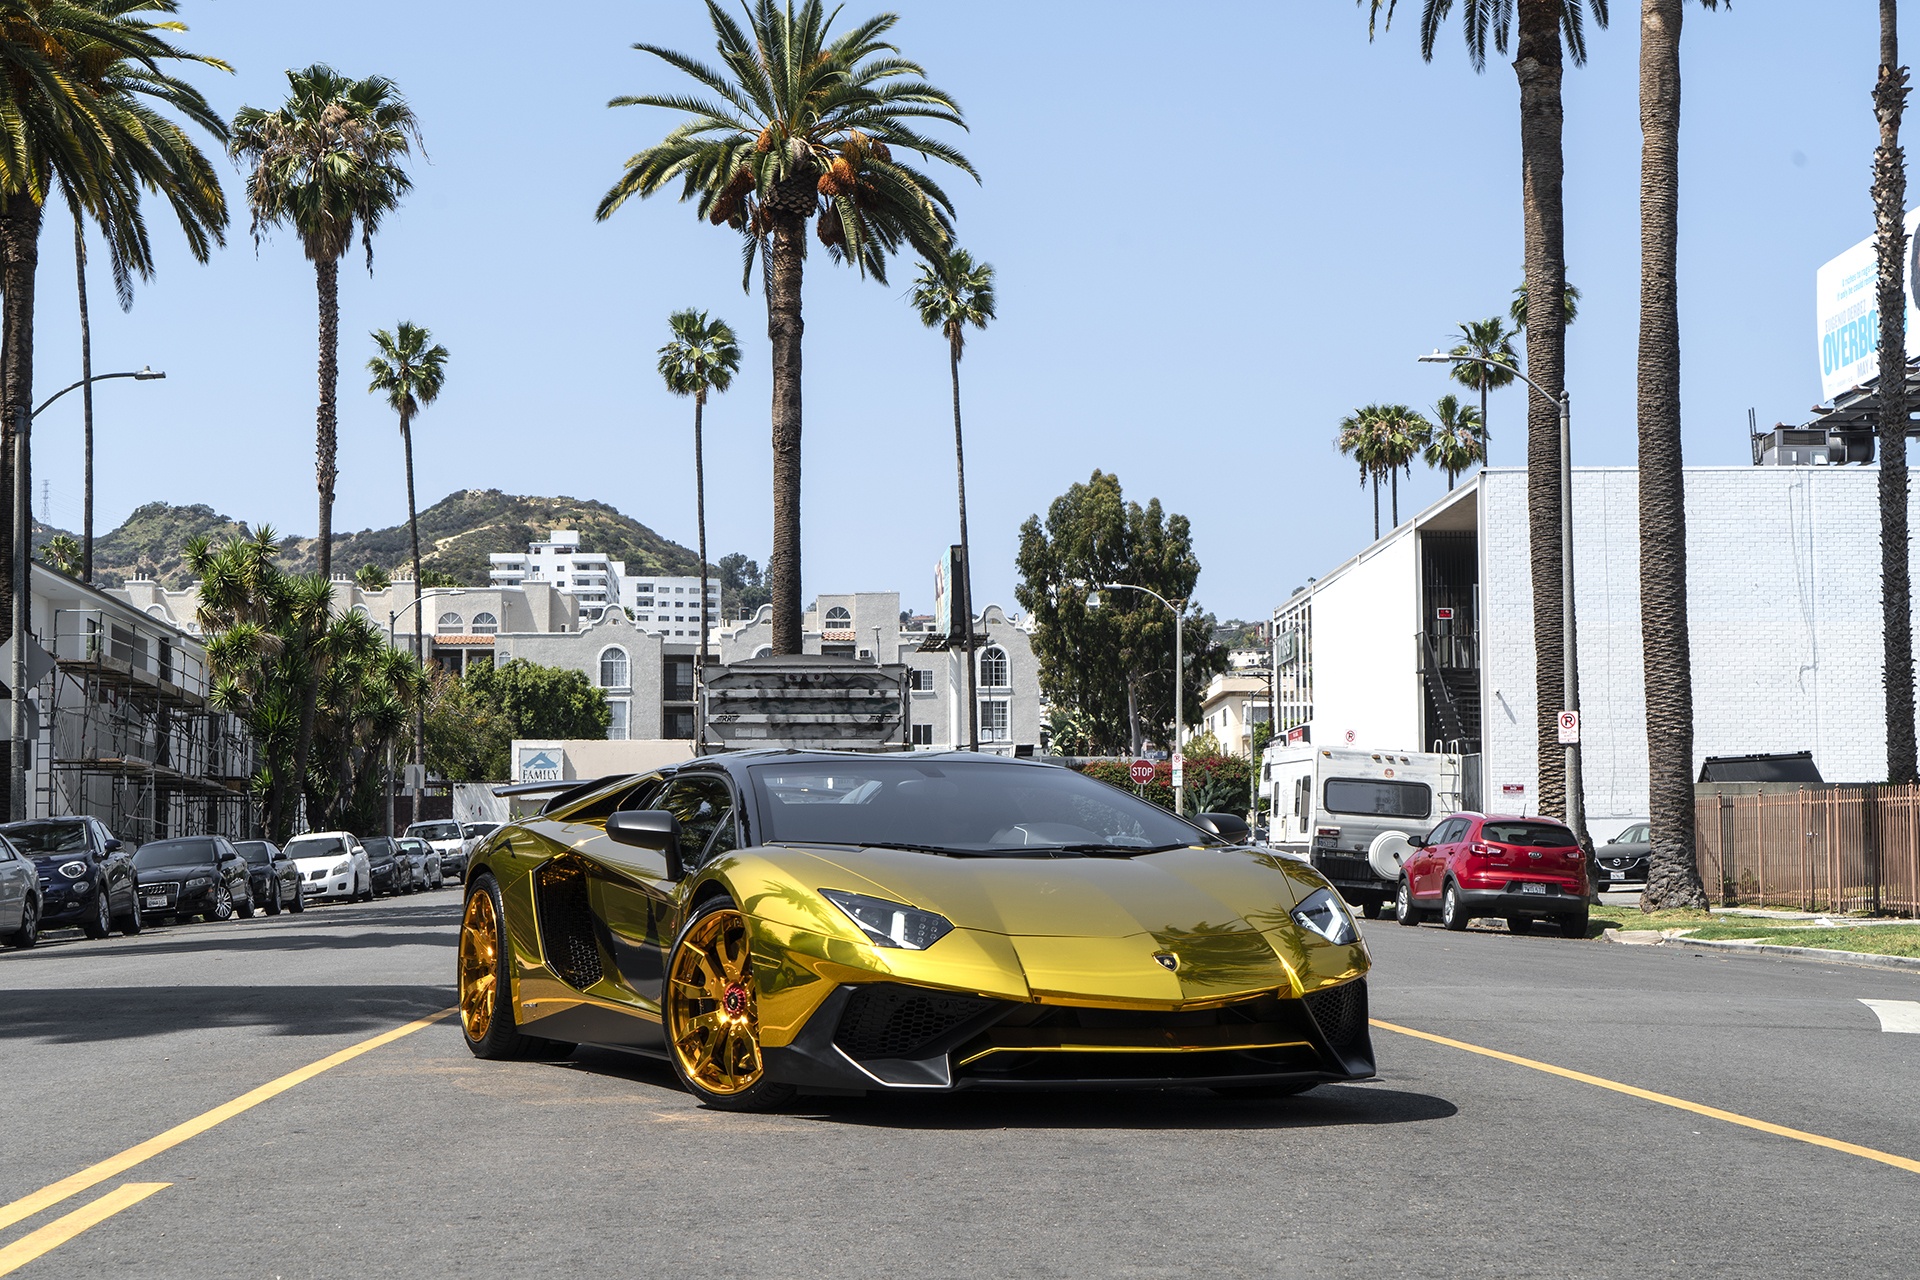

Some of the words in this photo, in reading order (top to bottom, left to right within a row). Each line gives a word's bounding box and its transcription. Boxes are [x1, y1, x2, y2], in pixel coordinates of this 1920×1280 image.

[1825, 310, 1846, 333] EUGENIO
[1847, 299, 1866, 321] DERBEZ
[1823, 309, 1880, 376] OVERBO
[1857, 359, 1869, 378] MAY
[522, 769, 559, 780] FAMILY
[1132, 767, 1153, 777] STOP
